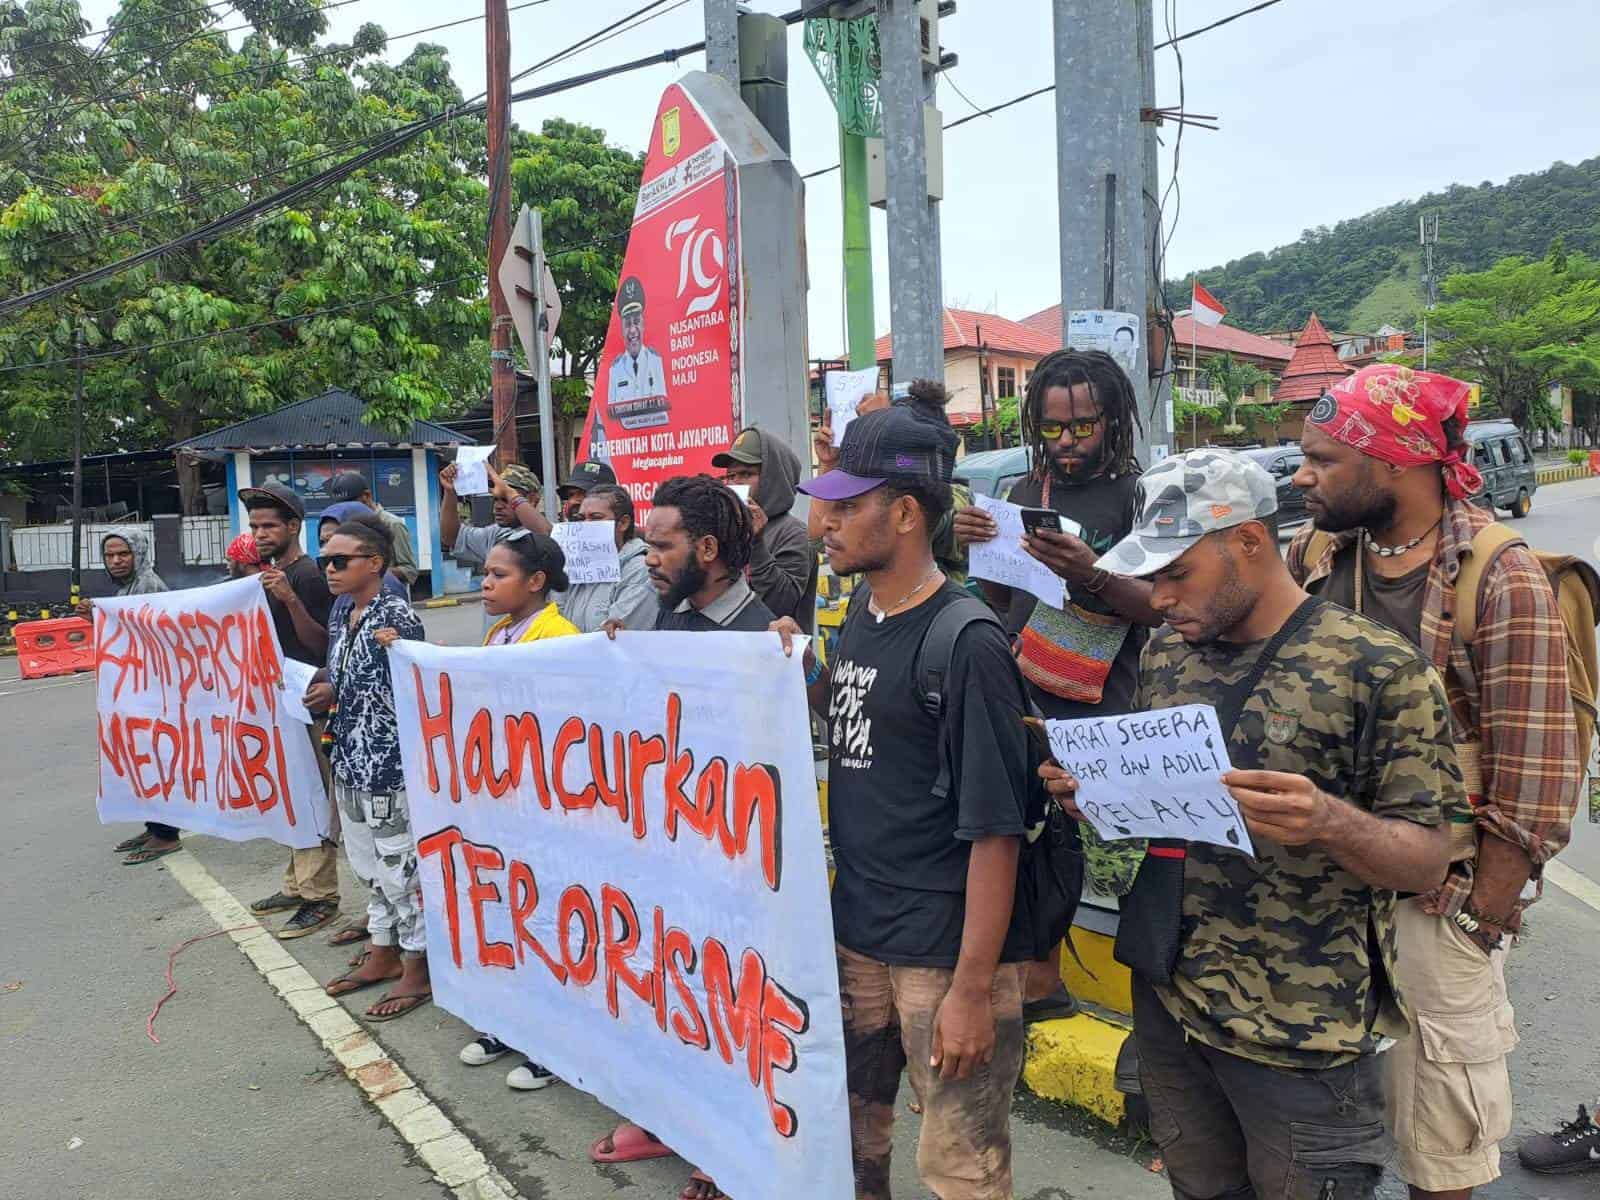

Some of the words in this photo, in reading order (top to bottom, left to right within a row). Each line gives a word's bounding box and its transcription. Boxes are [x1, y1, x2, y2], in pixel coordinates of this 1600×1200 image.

[665, 214, 725, 317] 79
[669, 309, 725, 336] NUSANTARA
[670, 334, 695, 352] BARU
[671, 349, 720, 371] INDONESIA
[672, 369, 697, 386] MAJU
[590, 435, 648, 459] PEMERINTAH
[650, 431, 676, 453] KOTA
[677, 425, 729, 450] JAYAPURA
[1116, 711, 1209, 746] SEGERA
[96, 704, 208, 804] MEDIA
[210, 714, 297, 827] JUBI
[412, 662, 782, 892] Hancurkan
[1084, 796, 1244, 832] PELAKU
[416, 825, 809, 1138] TERORISME
